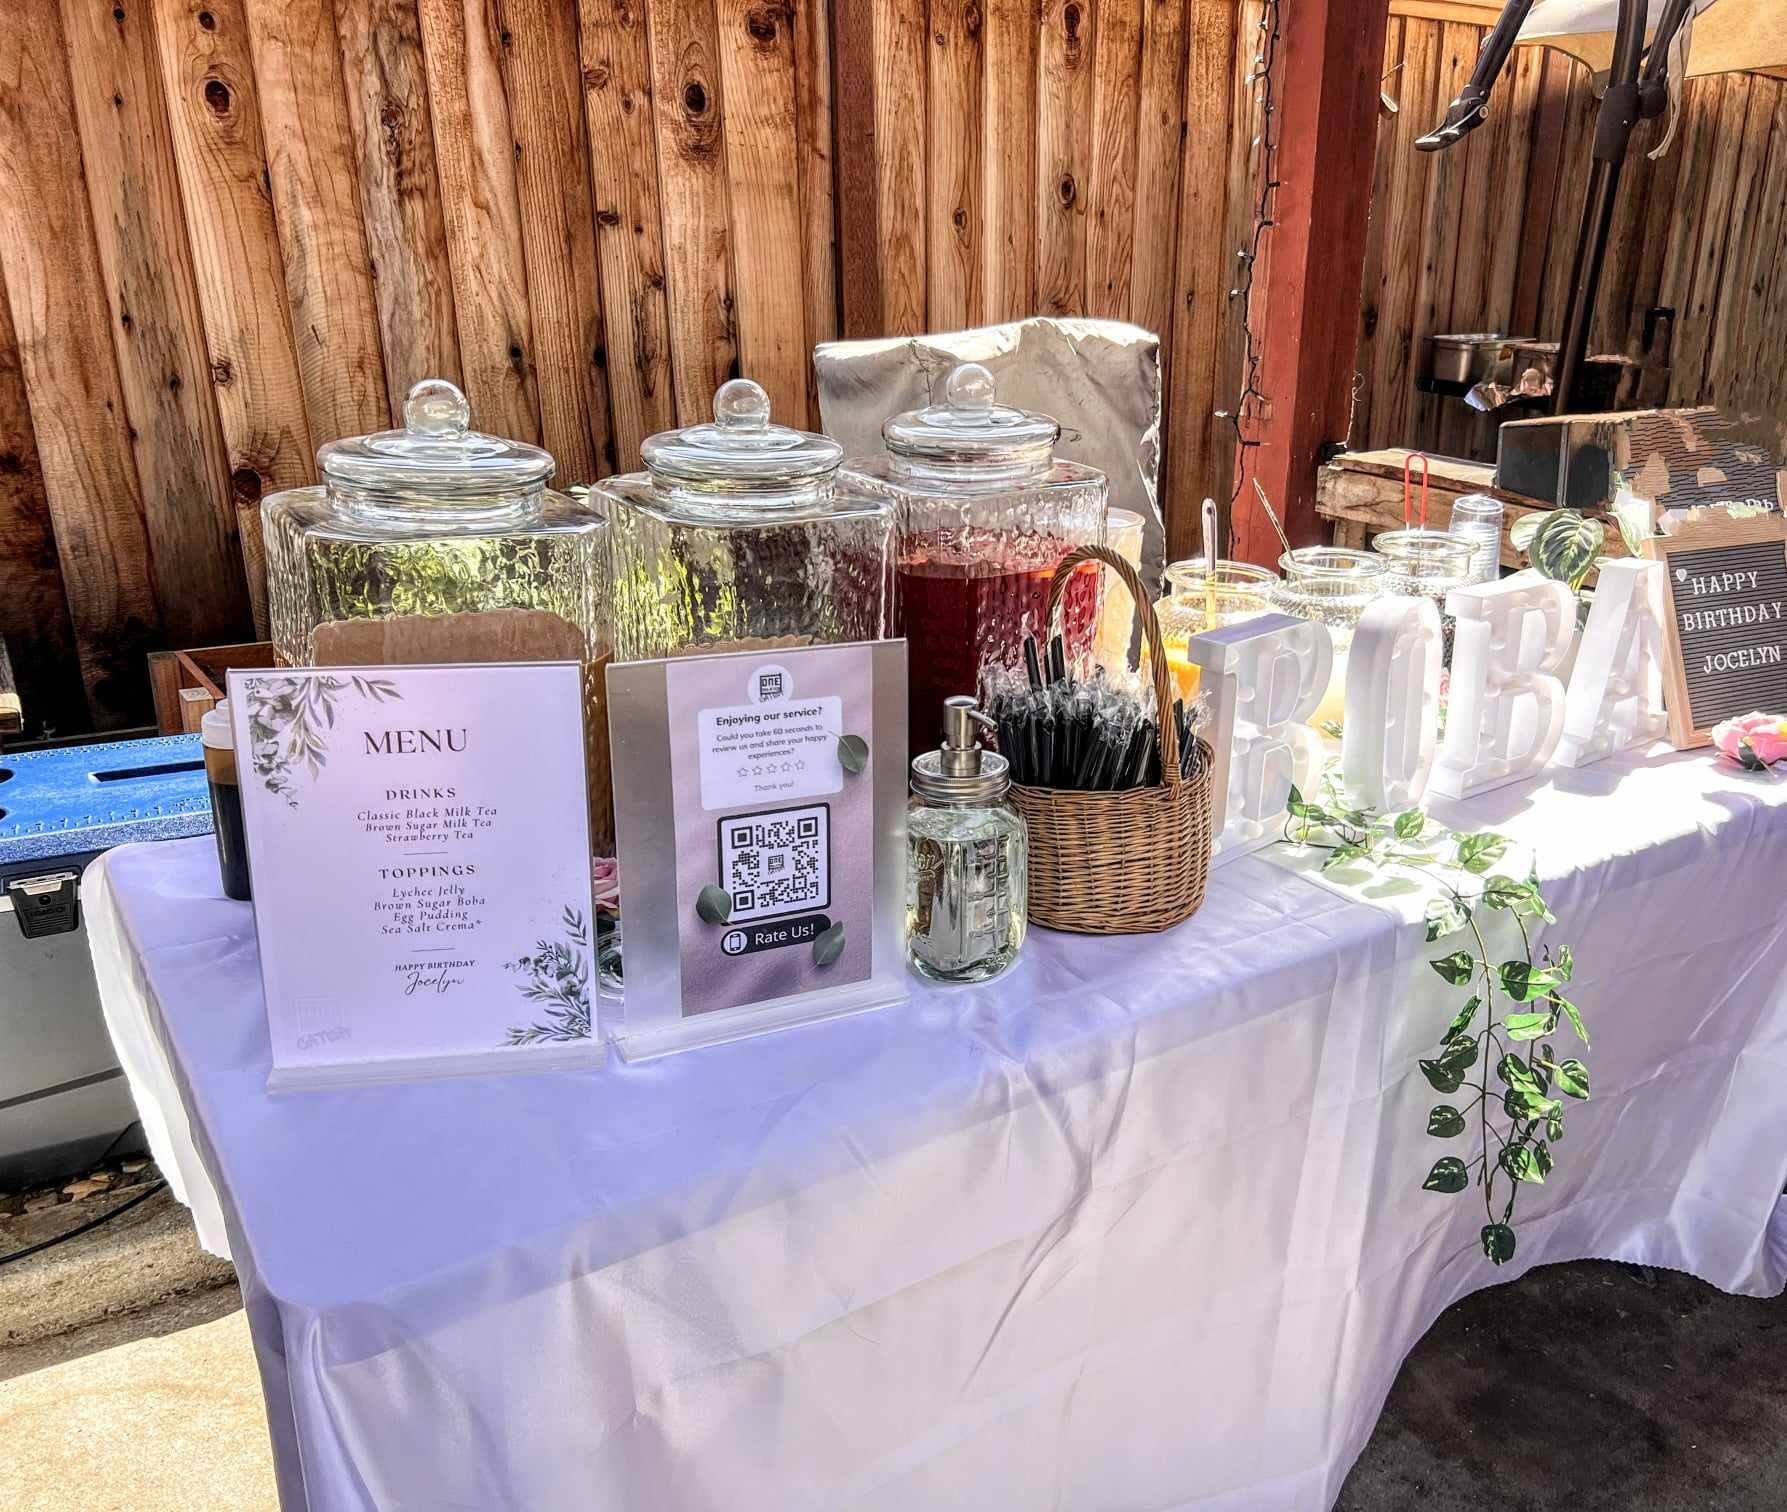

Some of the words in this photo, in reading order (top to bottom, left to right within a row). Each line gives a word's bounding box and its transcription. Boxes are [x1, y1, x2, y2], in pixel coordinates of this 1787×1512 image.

[1692, 571, 1758, 595] HAPPY
[1683, 602, 1781, 631] BIRTHDAY
[1703, 645, 1781, 674] JOCELYN
[1188, 557, 1668, 853] BOBA
[716, 714, 760, 726] Enjoying
[763, 711, 780, 721] our
[783, 706, 822, 719] service?
[716, 732, 739, 742] Could
[740, 732, 754, 742] you
[755, 730, 772, 738] take
[784, 725, 814, 734] seconds
[364, 729, 467, 755] MENU
[712, 744, 737, 753] review
[739, 743, 748, 751] us
[749, 741, 764, 749] and
[766, 738, 786, 747] share
[788, 737, 803, 746] your
[804, 734, 827, 744] happy
[748, 747, 795, 760] experiences?
[386, 787, 456, 800] DRINKS
[754, 784, 777, 792] Thank
[779, 781, 794, 790] you!
[357, 810, 400, 821] Classic
[406, 807, 439, 819] Black
[444, 806, 472, 818] Milk
[477, 806, 497, 816] Tea
[365, 822, 401, 832] Brown
[406, 821, 438, 833] Sugar
[443, 818, 468, 828] Milk
[473, 818, 492, 827] Tea
[386, 830, 449, 843] Strawberry
[455, 830, 473, 839] Tea
[379, 864, 476, 879] TOPPINGS
[392, 886, 433, 900] Lychee
[438, 884, 465, 896] Jelly
[374, 901, 411, 911] Brown
[417, 898, 451, 911] Sugar
[457, 895, 485, 906] Boba
[394, 912, 414, 924] Egg
[420, 909, 468, 921] Pudding
[381, 925, 401, 935] Sea
[407, 922, 431, 933] Salt
[755, 930, 787, 945] Rate
[791, 923, 814, 938] Us!
[395, 962, 425, 971] HAPPY
[427, 960, 475, 970] BIRTHDAY
[405, 969, 464, 996] Jocelyn
